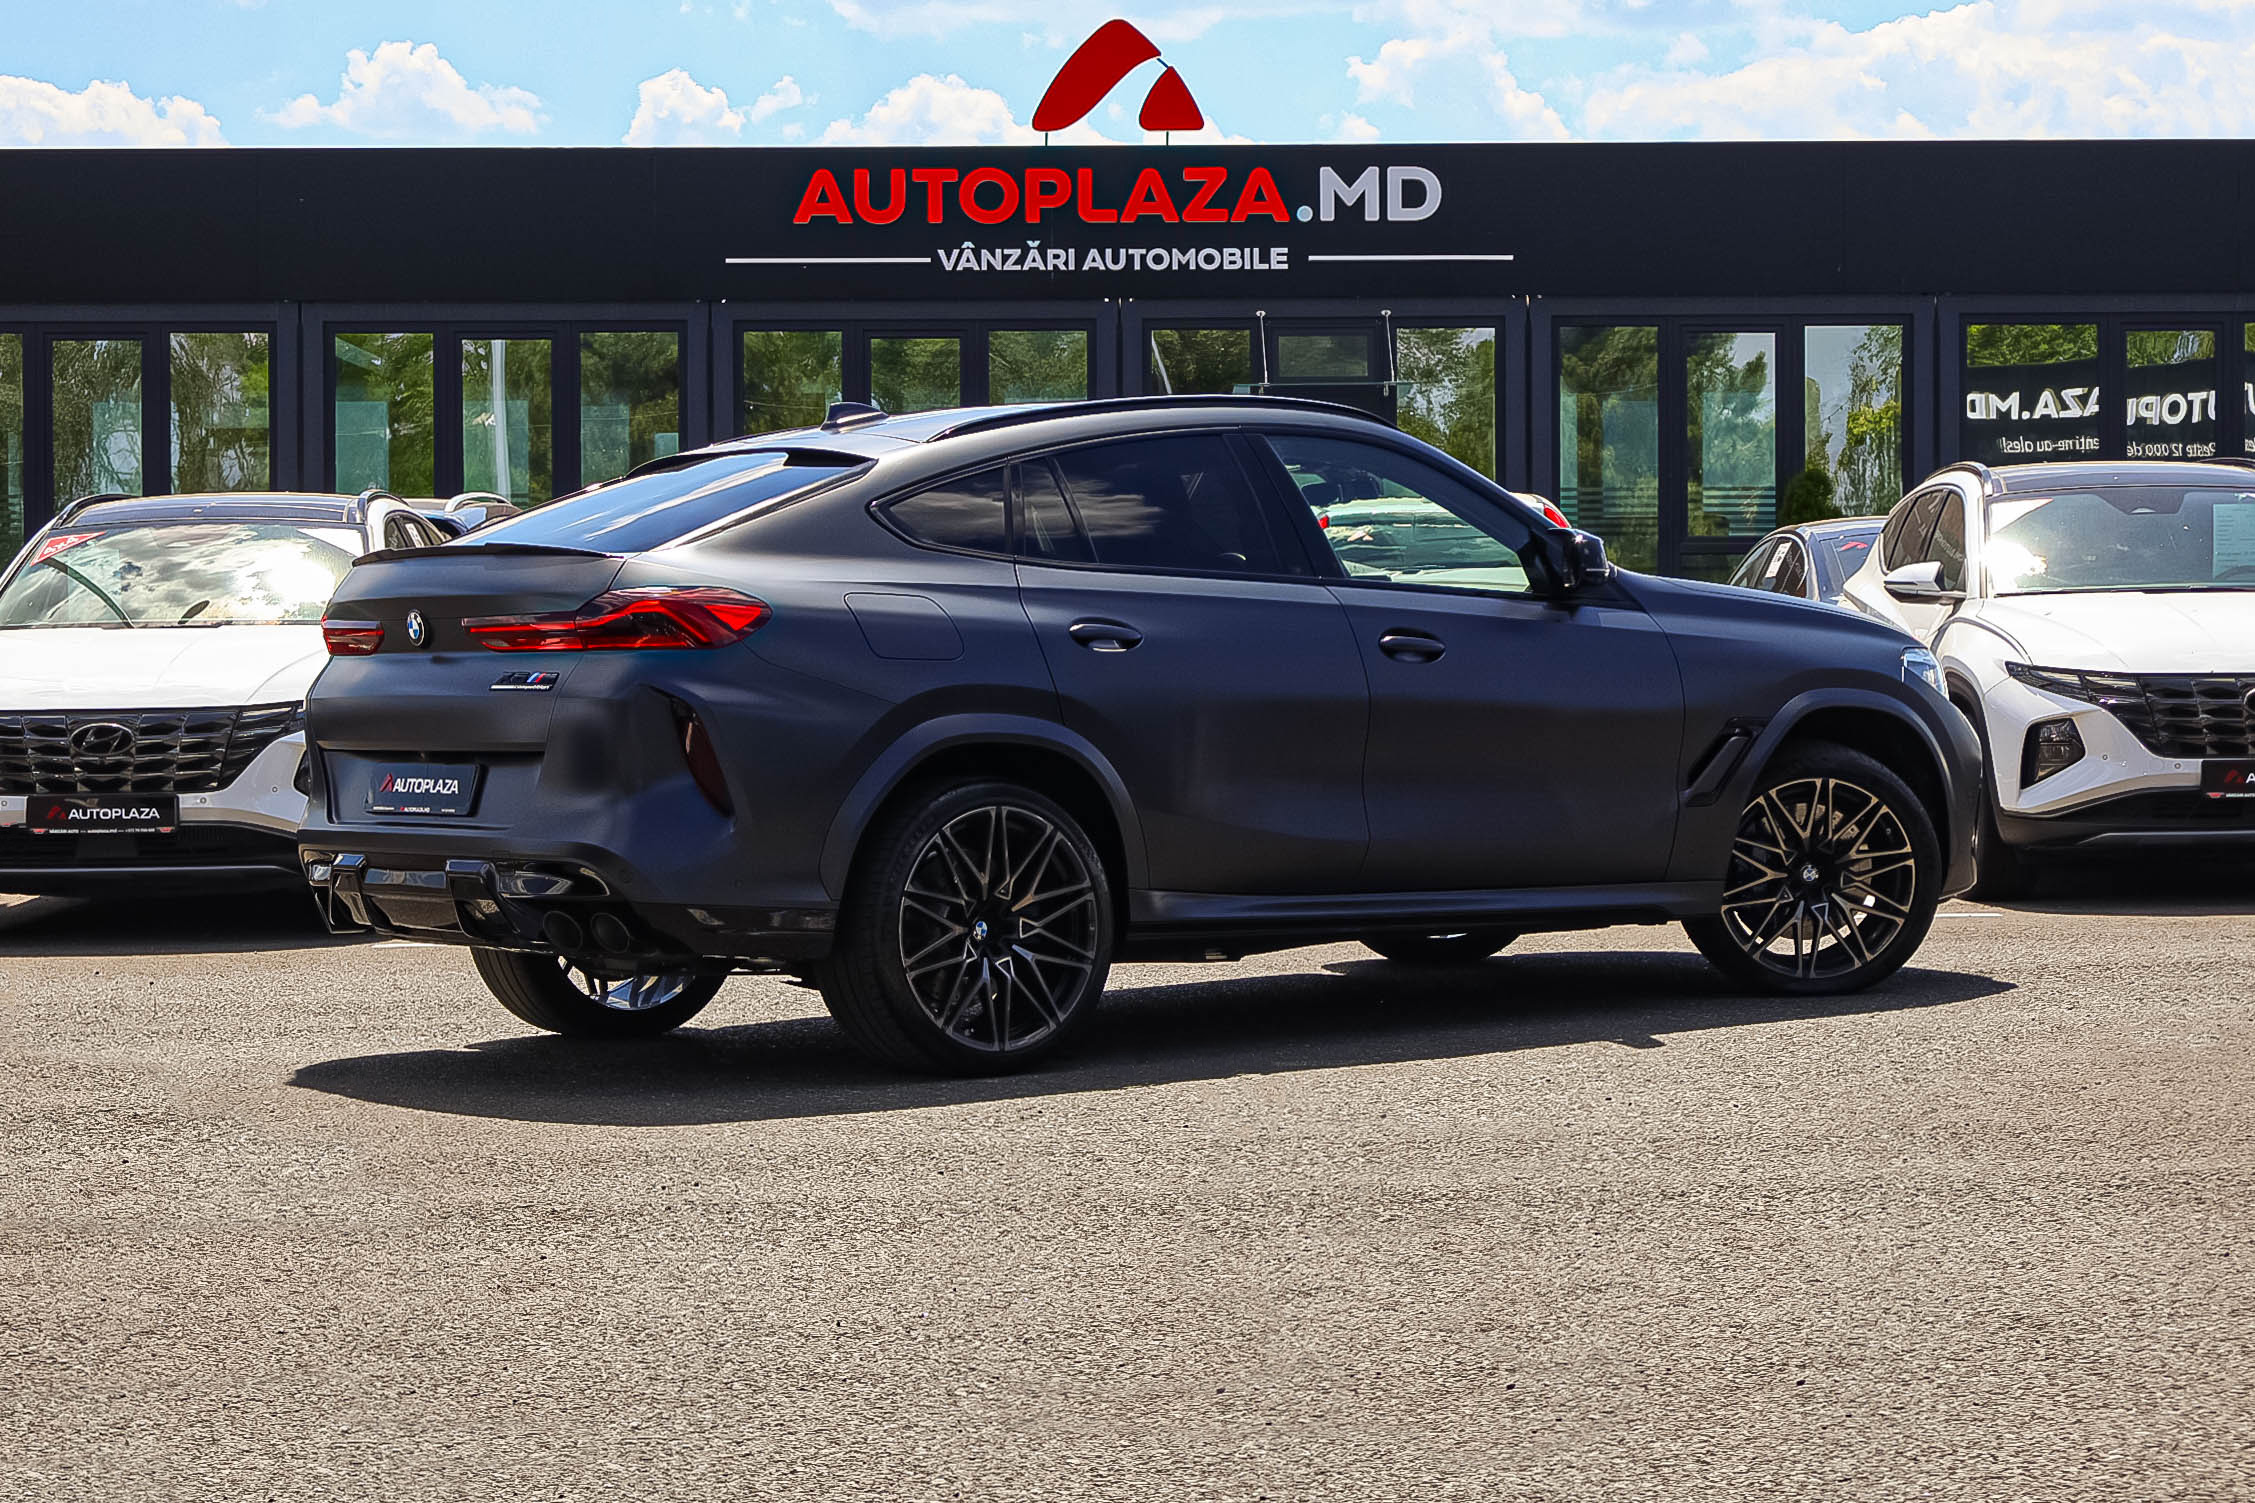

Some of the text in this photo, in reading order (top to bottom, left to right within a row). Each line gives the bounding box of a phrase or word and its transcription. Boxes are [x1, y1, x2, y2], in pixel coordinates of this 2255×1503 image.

[793, 165, 1442, 225] AUTOPLAZA.MD
[937, 240, 1289, 272] VÂNZĂRI AUTOMOBILE
[393, 778, 459, 794] AUTOPLAZA
[68, 808, 160, 820] AUTOPLAZA
